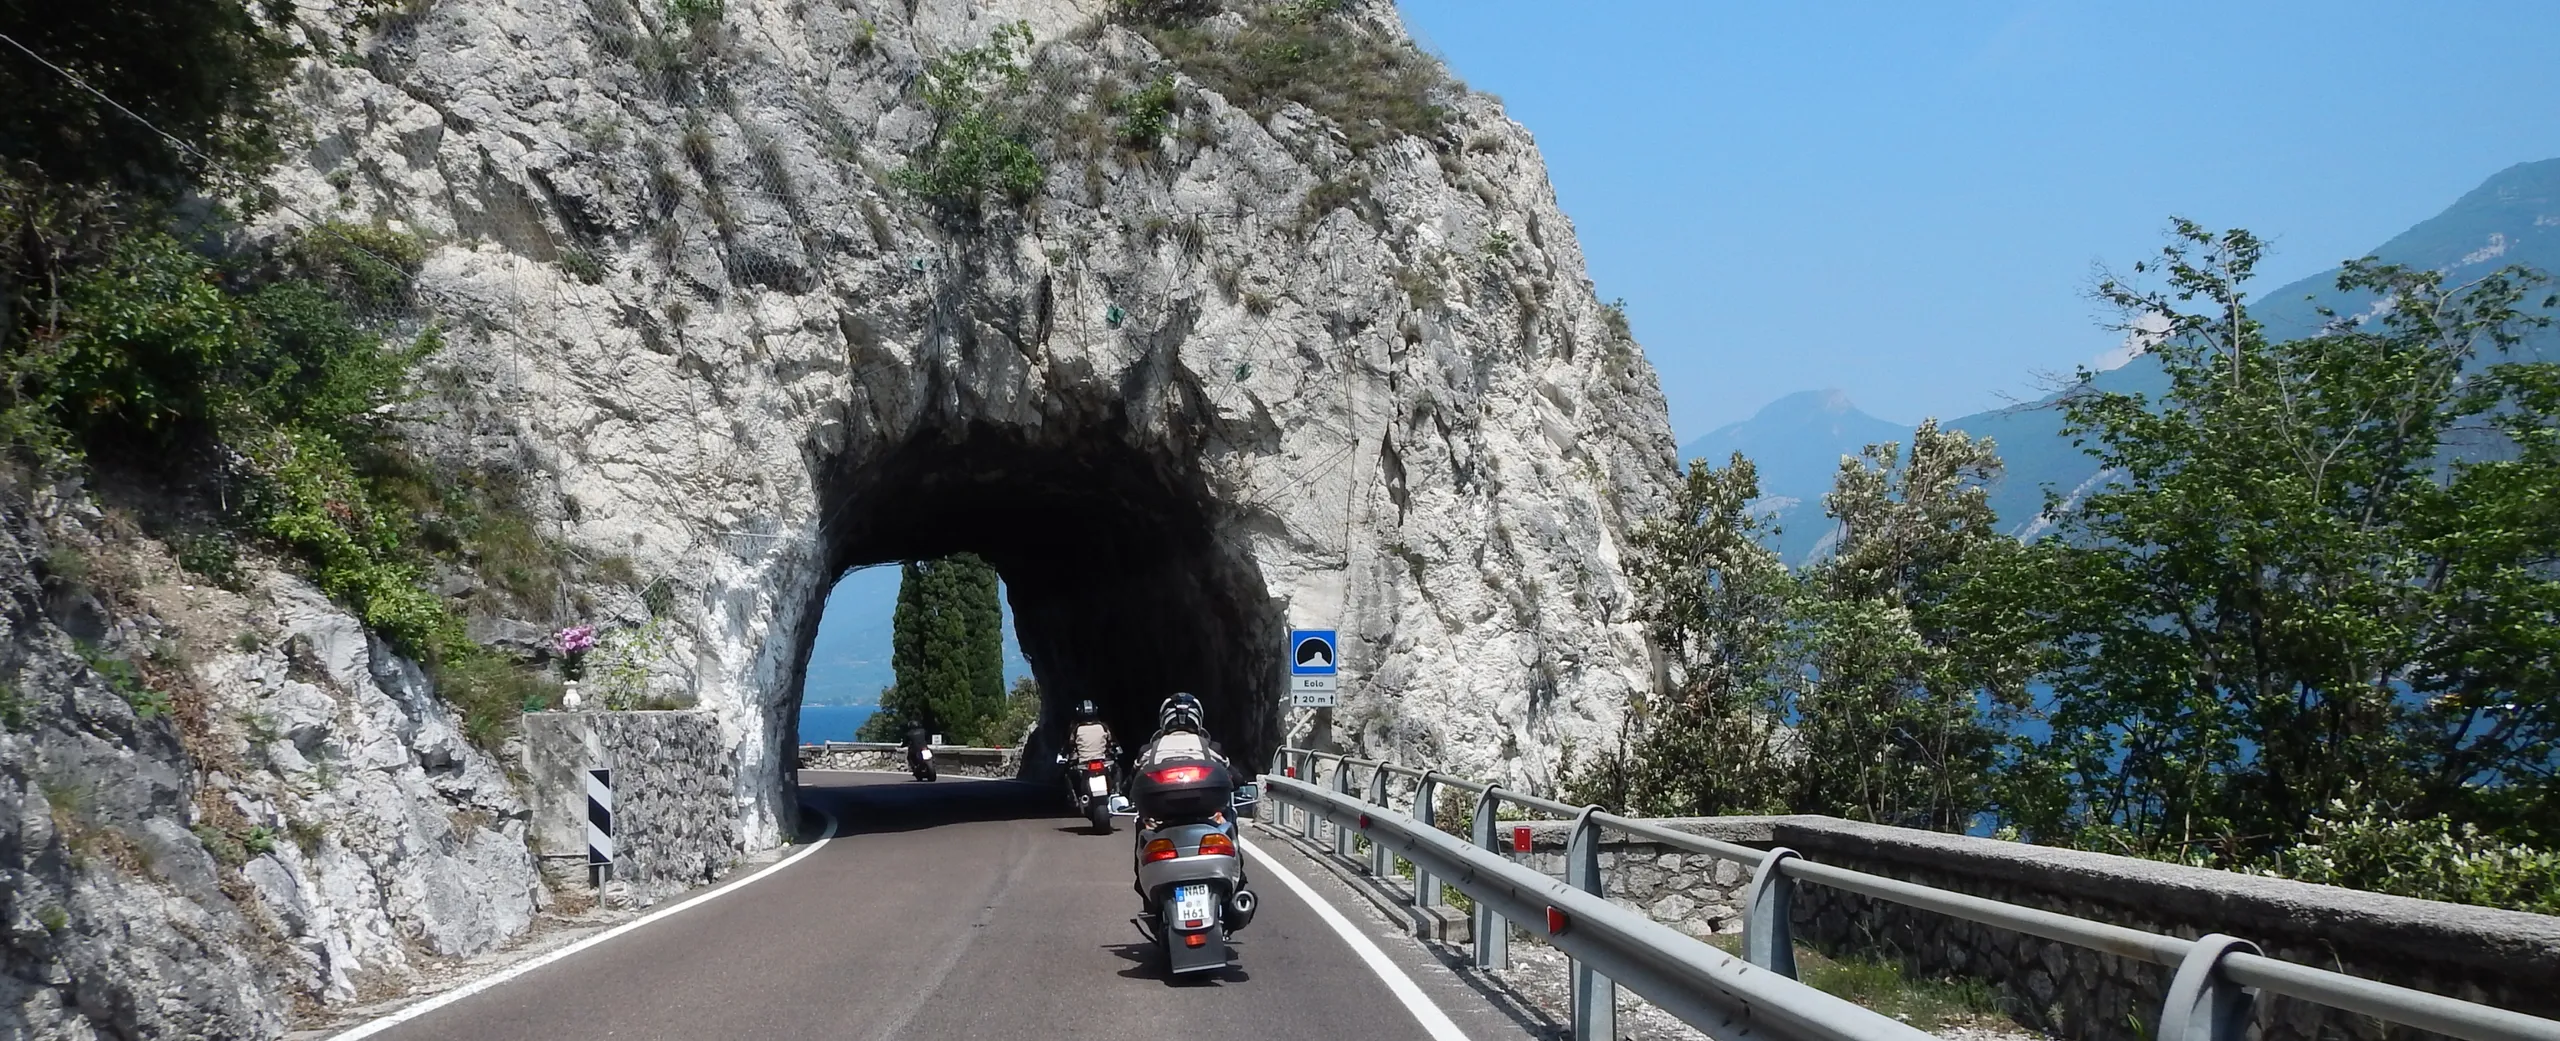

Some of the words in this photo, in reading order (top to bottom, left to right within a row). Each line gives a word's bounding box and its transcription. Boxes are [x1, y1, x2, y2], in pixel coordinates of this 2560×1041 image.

[1302, 695, 1315, 703] 20
[1184, 885, 1206, 896] NAB
[1183, 908, 1205, 919] H61
